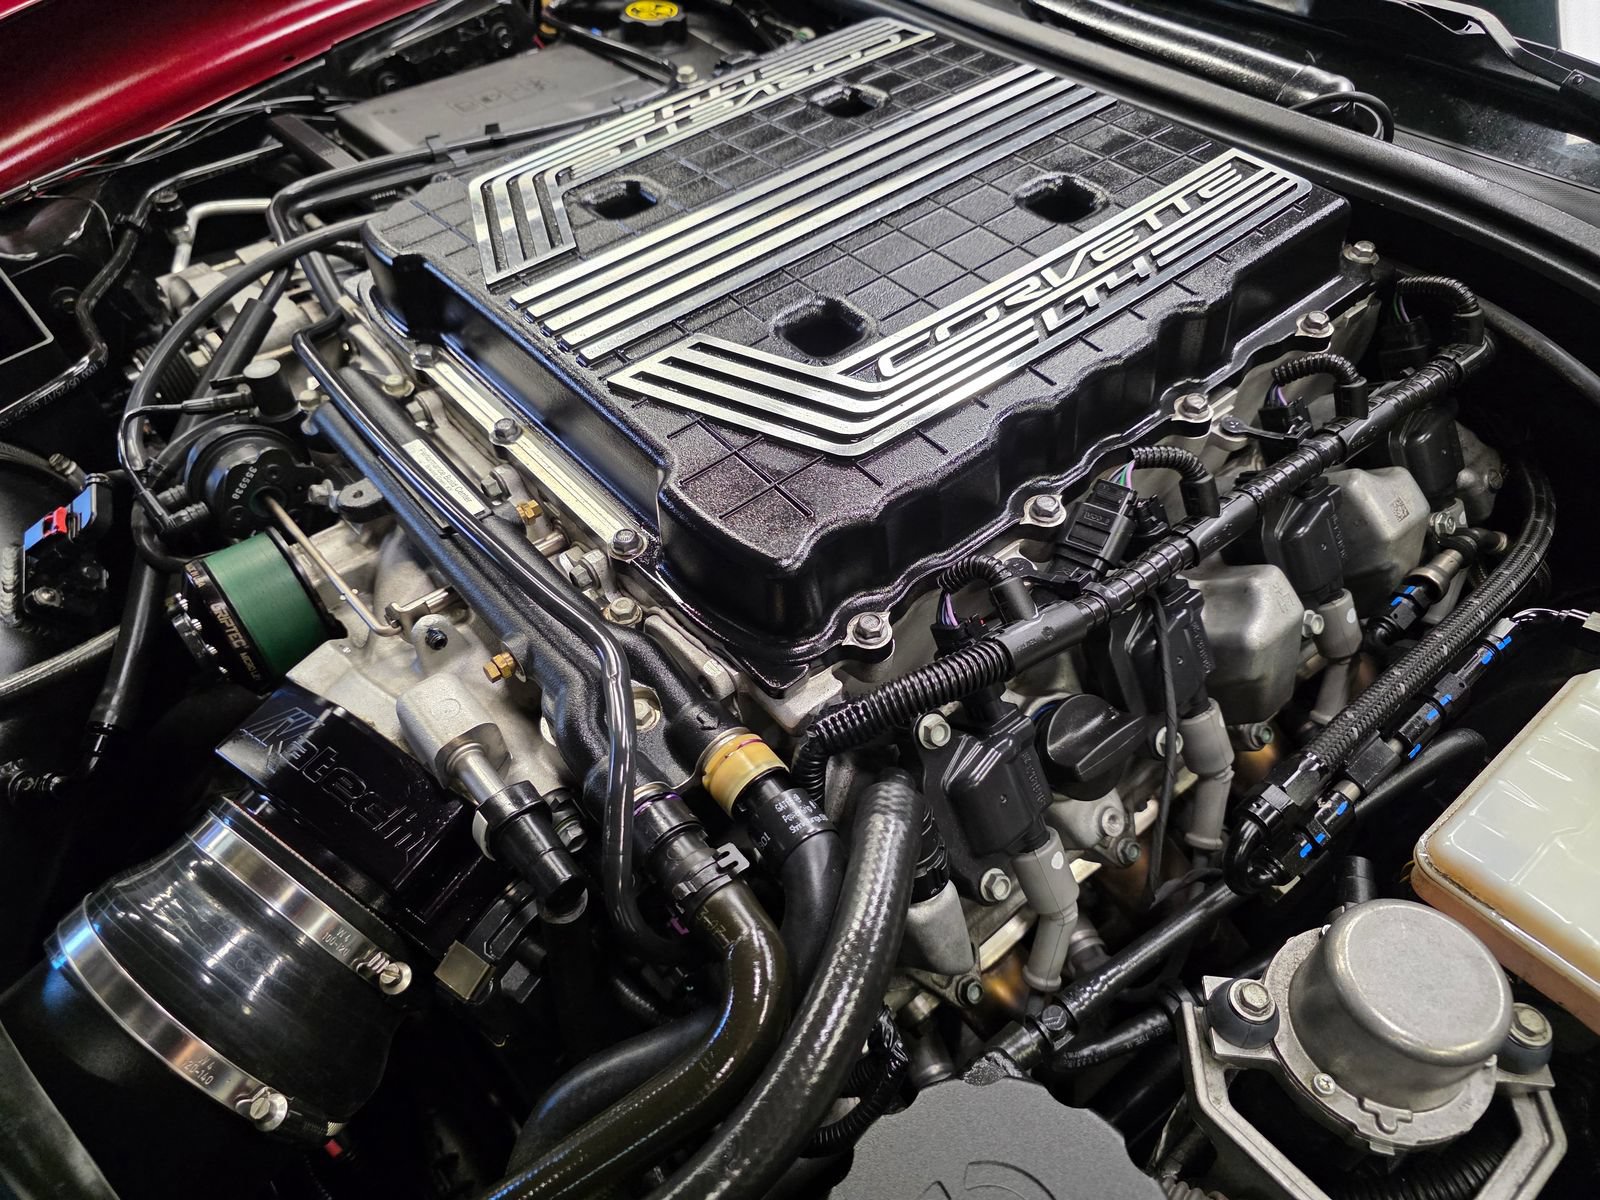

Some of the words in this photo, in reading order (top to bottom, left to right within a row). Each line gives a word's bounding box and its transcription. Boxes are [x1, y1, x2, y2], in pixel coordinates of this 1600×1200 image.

[878, 163, 1243, 379] CORVETTE
[1041, 255, 1153, 332] LT4
[321, 930, 350, 957] 100-120
